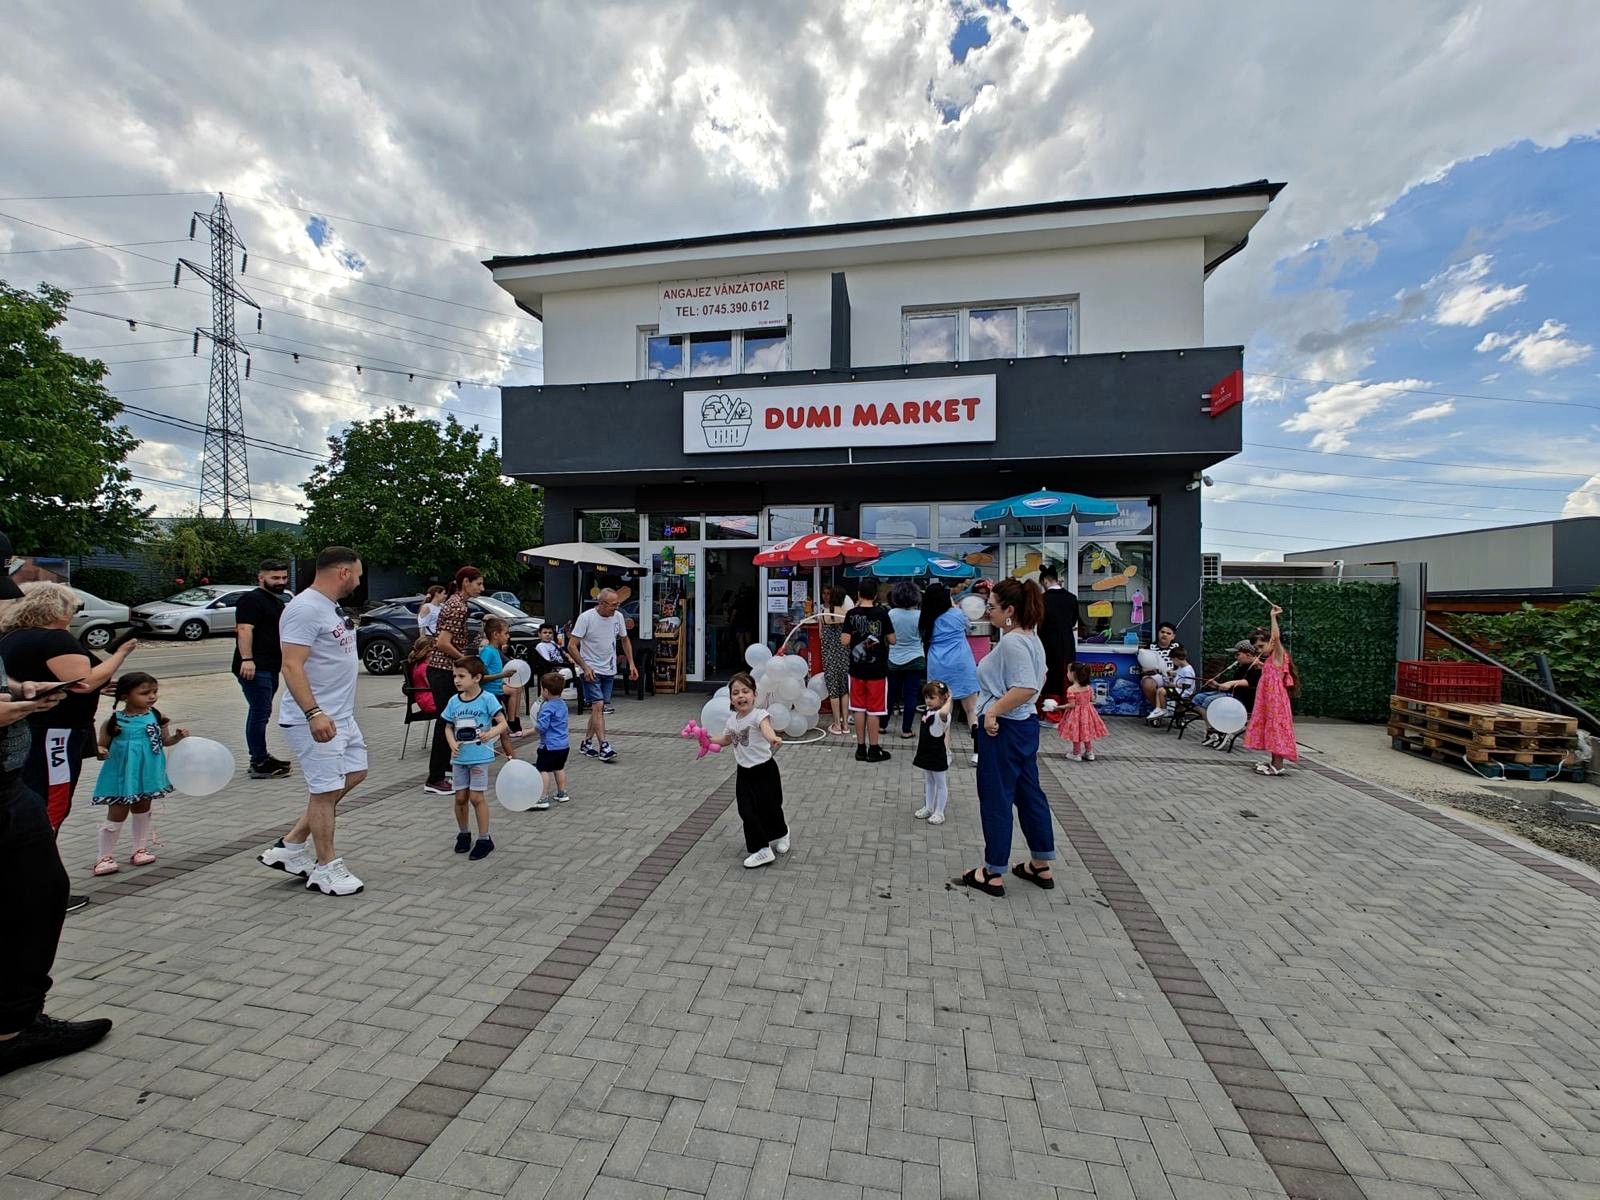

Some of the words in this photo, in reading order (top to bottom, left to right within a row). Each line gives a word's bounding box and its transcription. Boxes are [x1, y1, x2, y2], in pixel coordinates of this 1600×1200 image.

[663, 286, 712, 300] ANGAJEZ
[676, 306, 699, 317] TEL:
[702, 299, 770, 316] 0745.390.612
[764, 404, 842, 430] DUMI
[852, 397, 981, 427] MARKET
[51, 736, 65, 768] FILA
